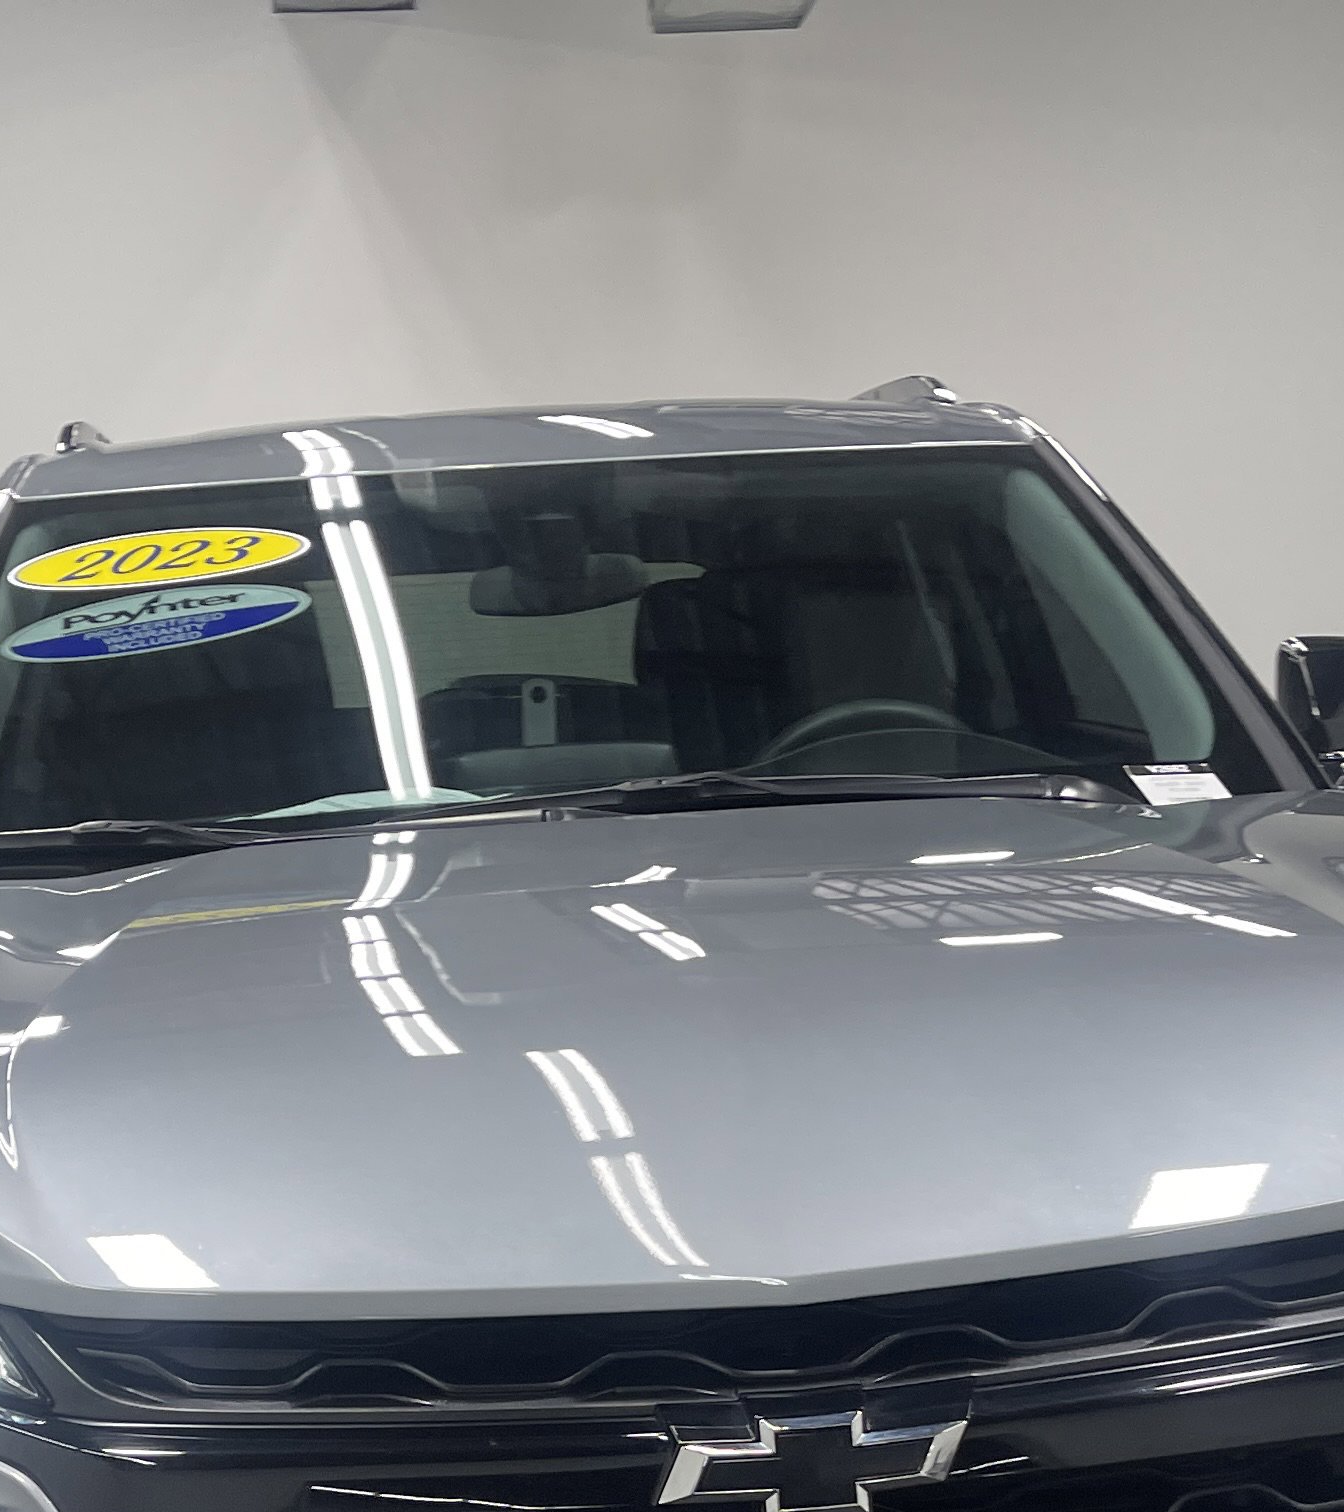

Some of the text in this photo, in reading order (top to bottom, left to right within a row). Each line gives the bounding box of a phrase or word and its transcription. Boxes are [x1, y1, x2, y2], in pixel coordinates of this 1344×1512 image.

[57, 535, 262, 583] 2023
[62, 592, 246, 630] Poynter
[102, 622, 206, 645] WARRANTY
[107, 631, 203, 652] INCLUDED
